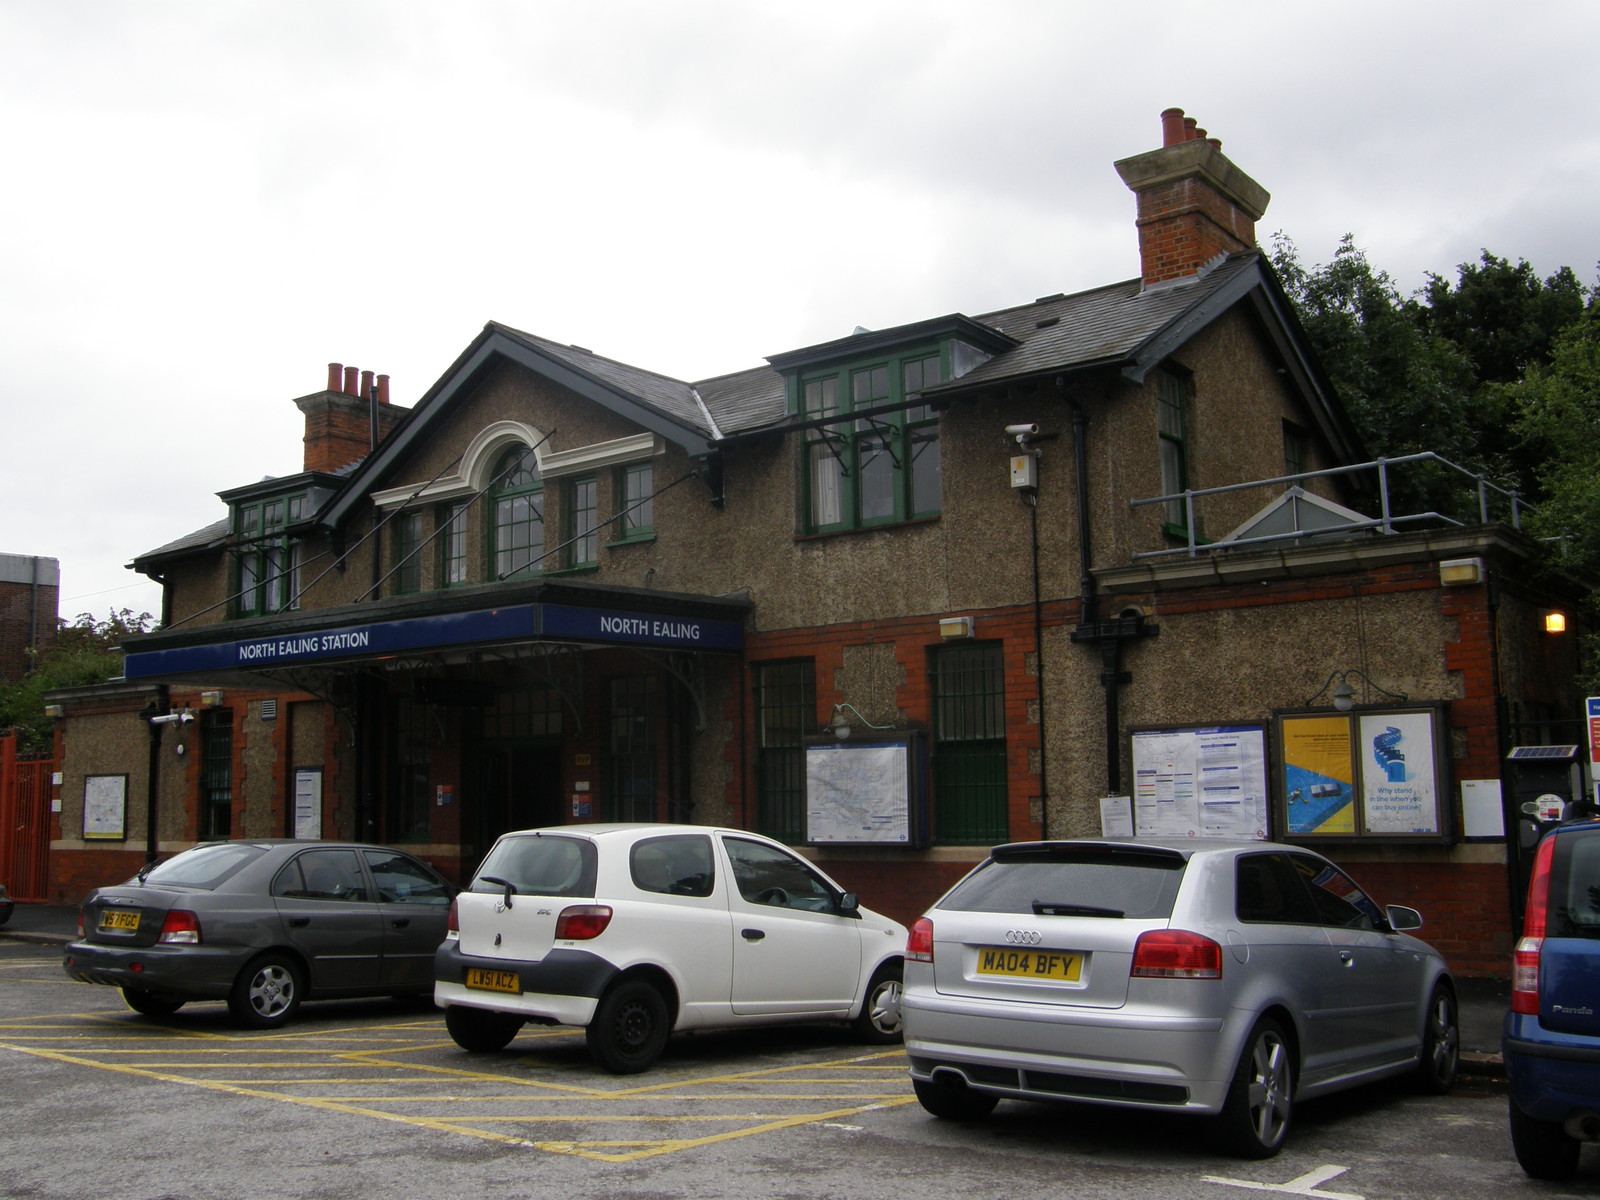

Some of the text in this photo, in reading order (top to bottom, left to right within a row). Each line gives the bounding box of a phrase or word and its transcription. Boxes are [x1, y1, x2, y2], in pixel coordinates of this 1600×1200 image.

[601, 616, 700, 640] NORTH EALING
[239, 631, 369, 660] NORTH EALING STATION
[1377, 787, 1392, 795] Why
[983, 951, 1074, 976] MA04 BFY
[495, 972, 514, 988] ACZ
[1552, 1004, 1594, 1015] Panda
